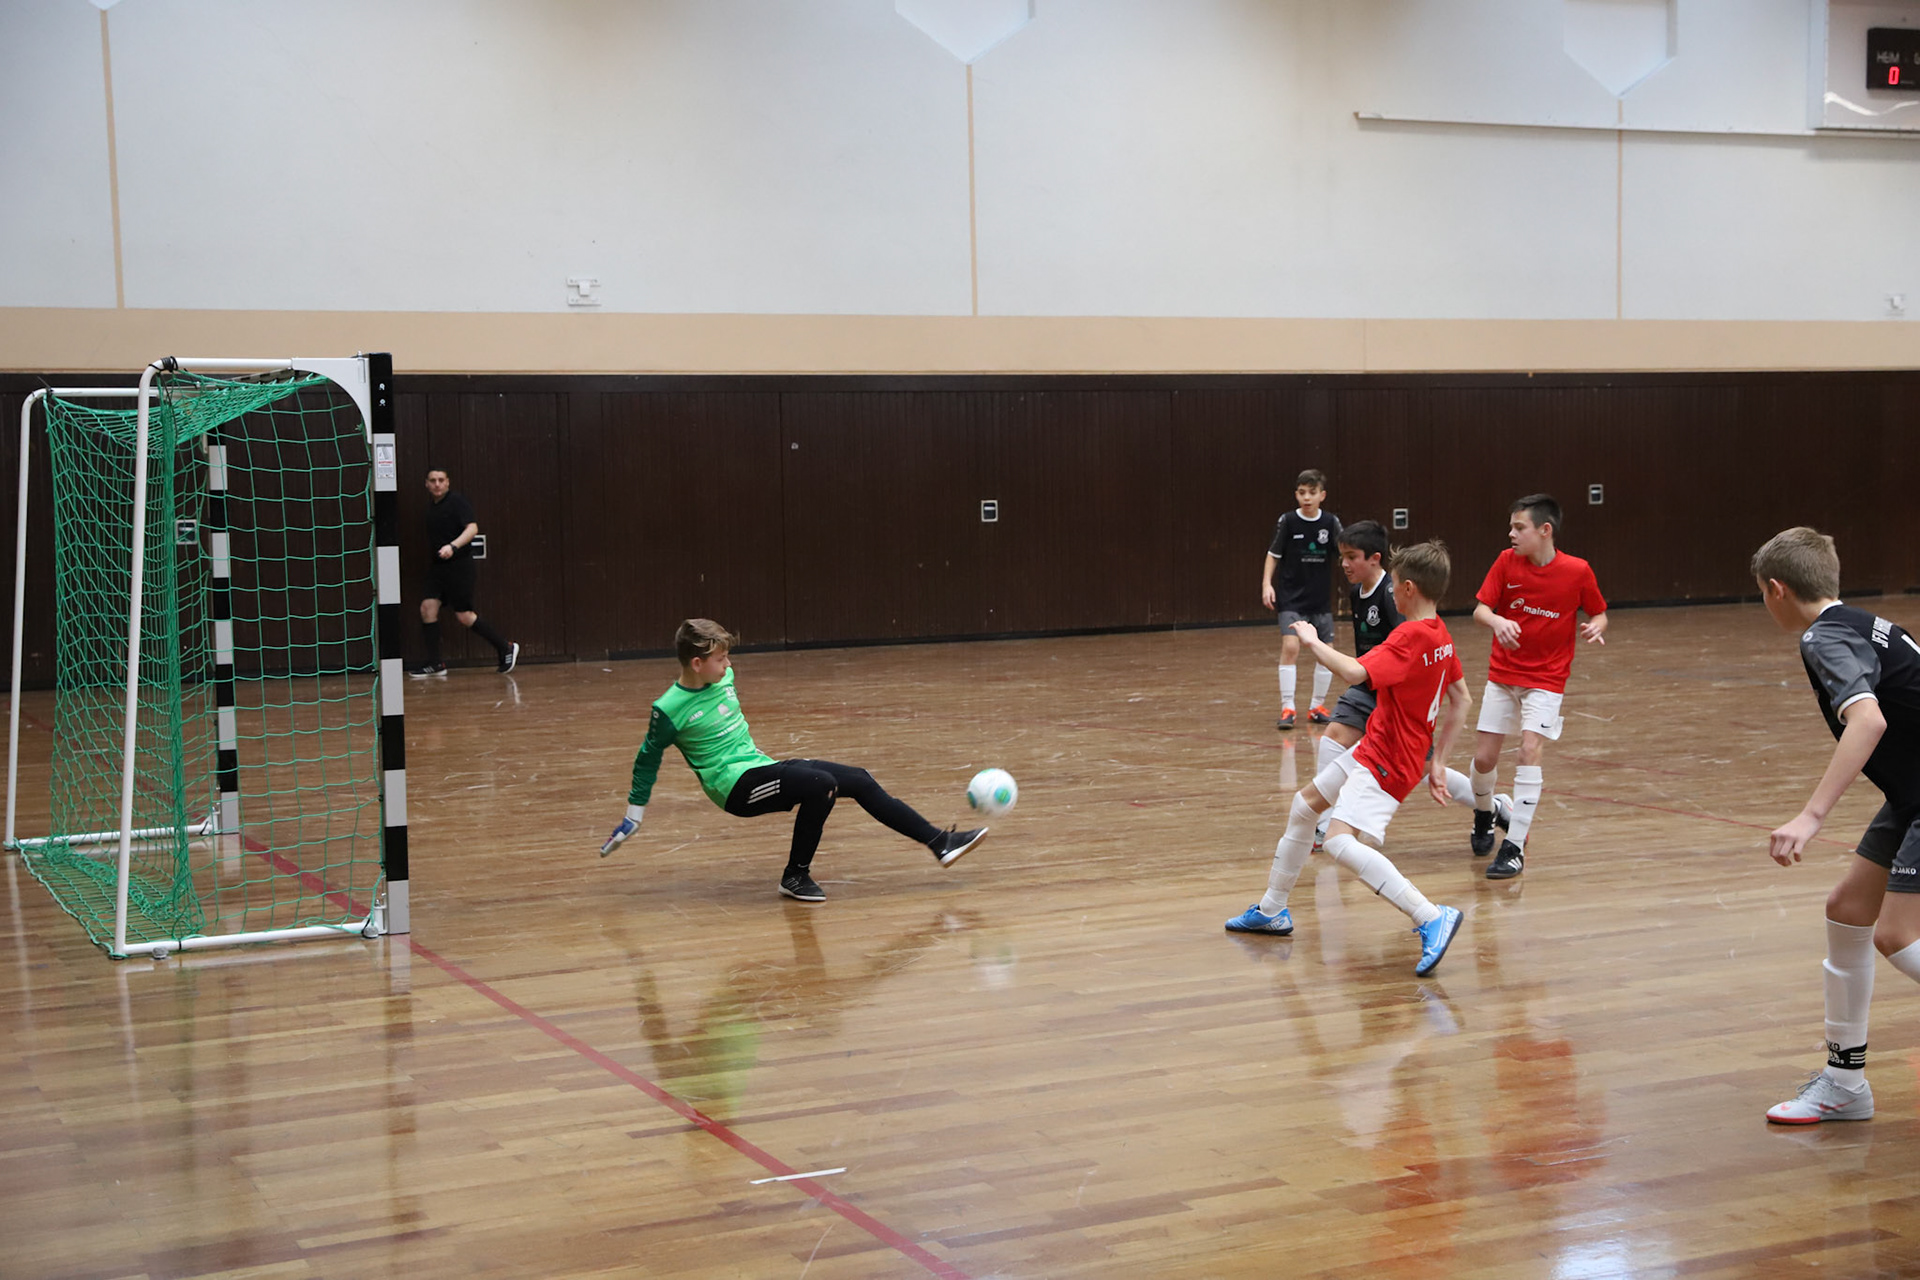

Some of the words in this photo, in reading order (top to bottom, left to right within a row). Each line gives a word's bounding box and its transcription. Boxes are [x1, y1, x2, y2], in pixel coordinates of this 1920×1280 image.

[1888, 66, 1900, 85] 0
[1523, 605, 1560, 619] mainova
[1427, 669, 1446, 727] 4
[1897, 867, 1917, 875] JAKO
